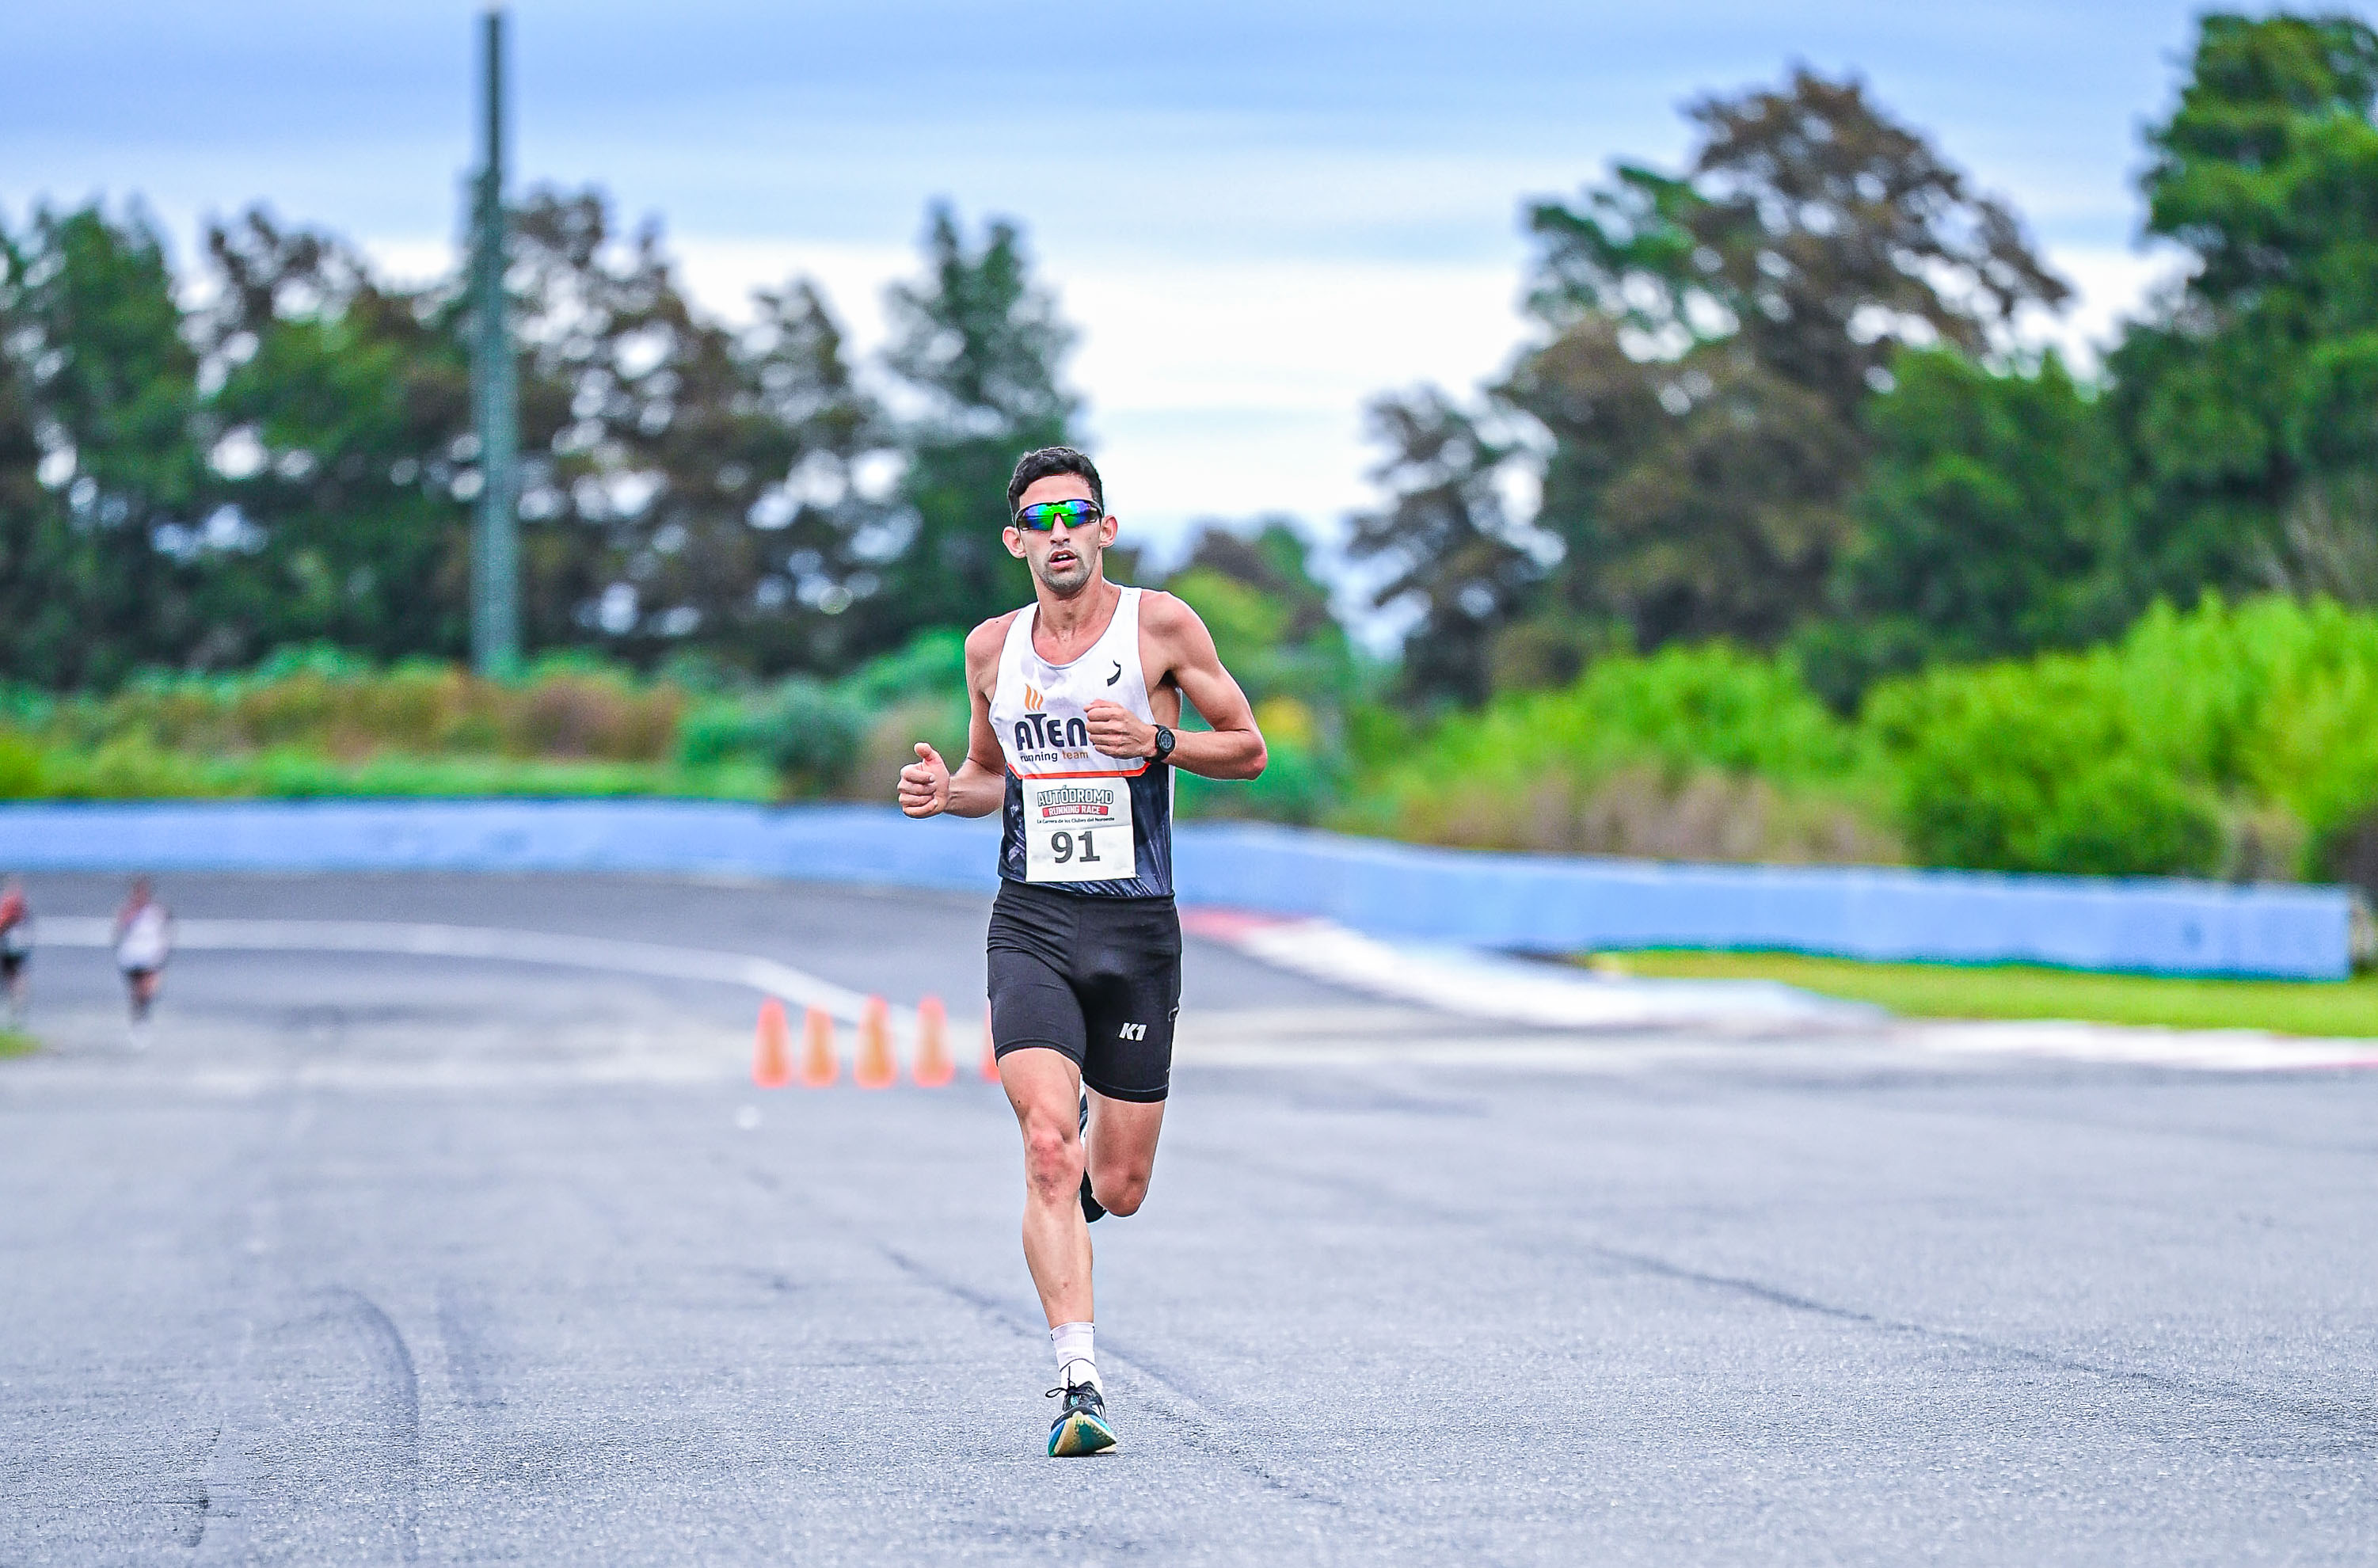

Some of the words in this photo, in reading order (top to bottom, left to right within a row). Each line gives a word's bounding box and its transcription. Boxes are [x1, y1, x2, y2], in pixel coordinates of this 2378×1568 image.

[1014, 714, 1095, 751] ATEN
[1020, 752, 1058, 762] running
[1062, 751, 1088, 759] team
[1037, 785, 1113, 807] AUTÓDROMO
[1048, 805, 1079, 816] RUNNING
[1081, 805, 1101, 814] RACE
[1051, 831, 1100, 863] 91
[1119, 1022, 1147, 1041] K1
